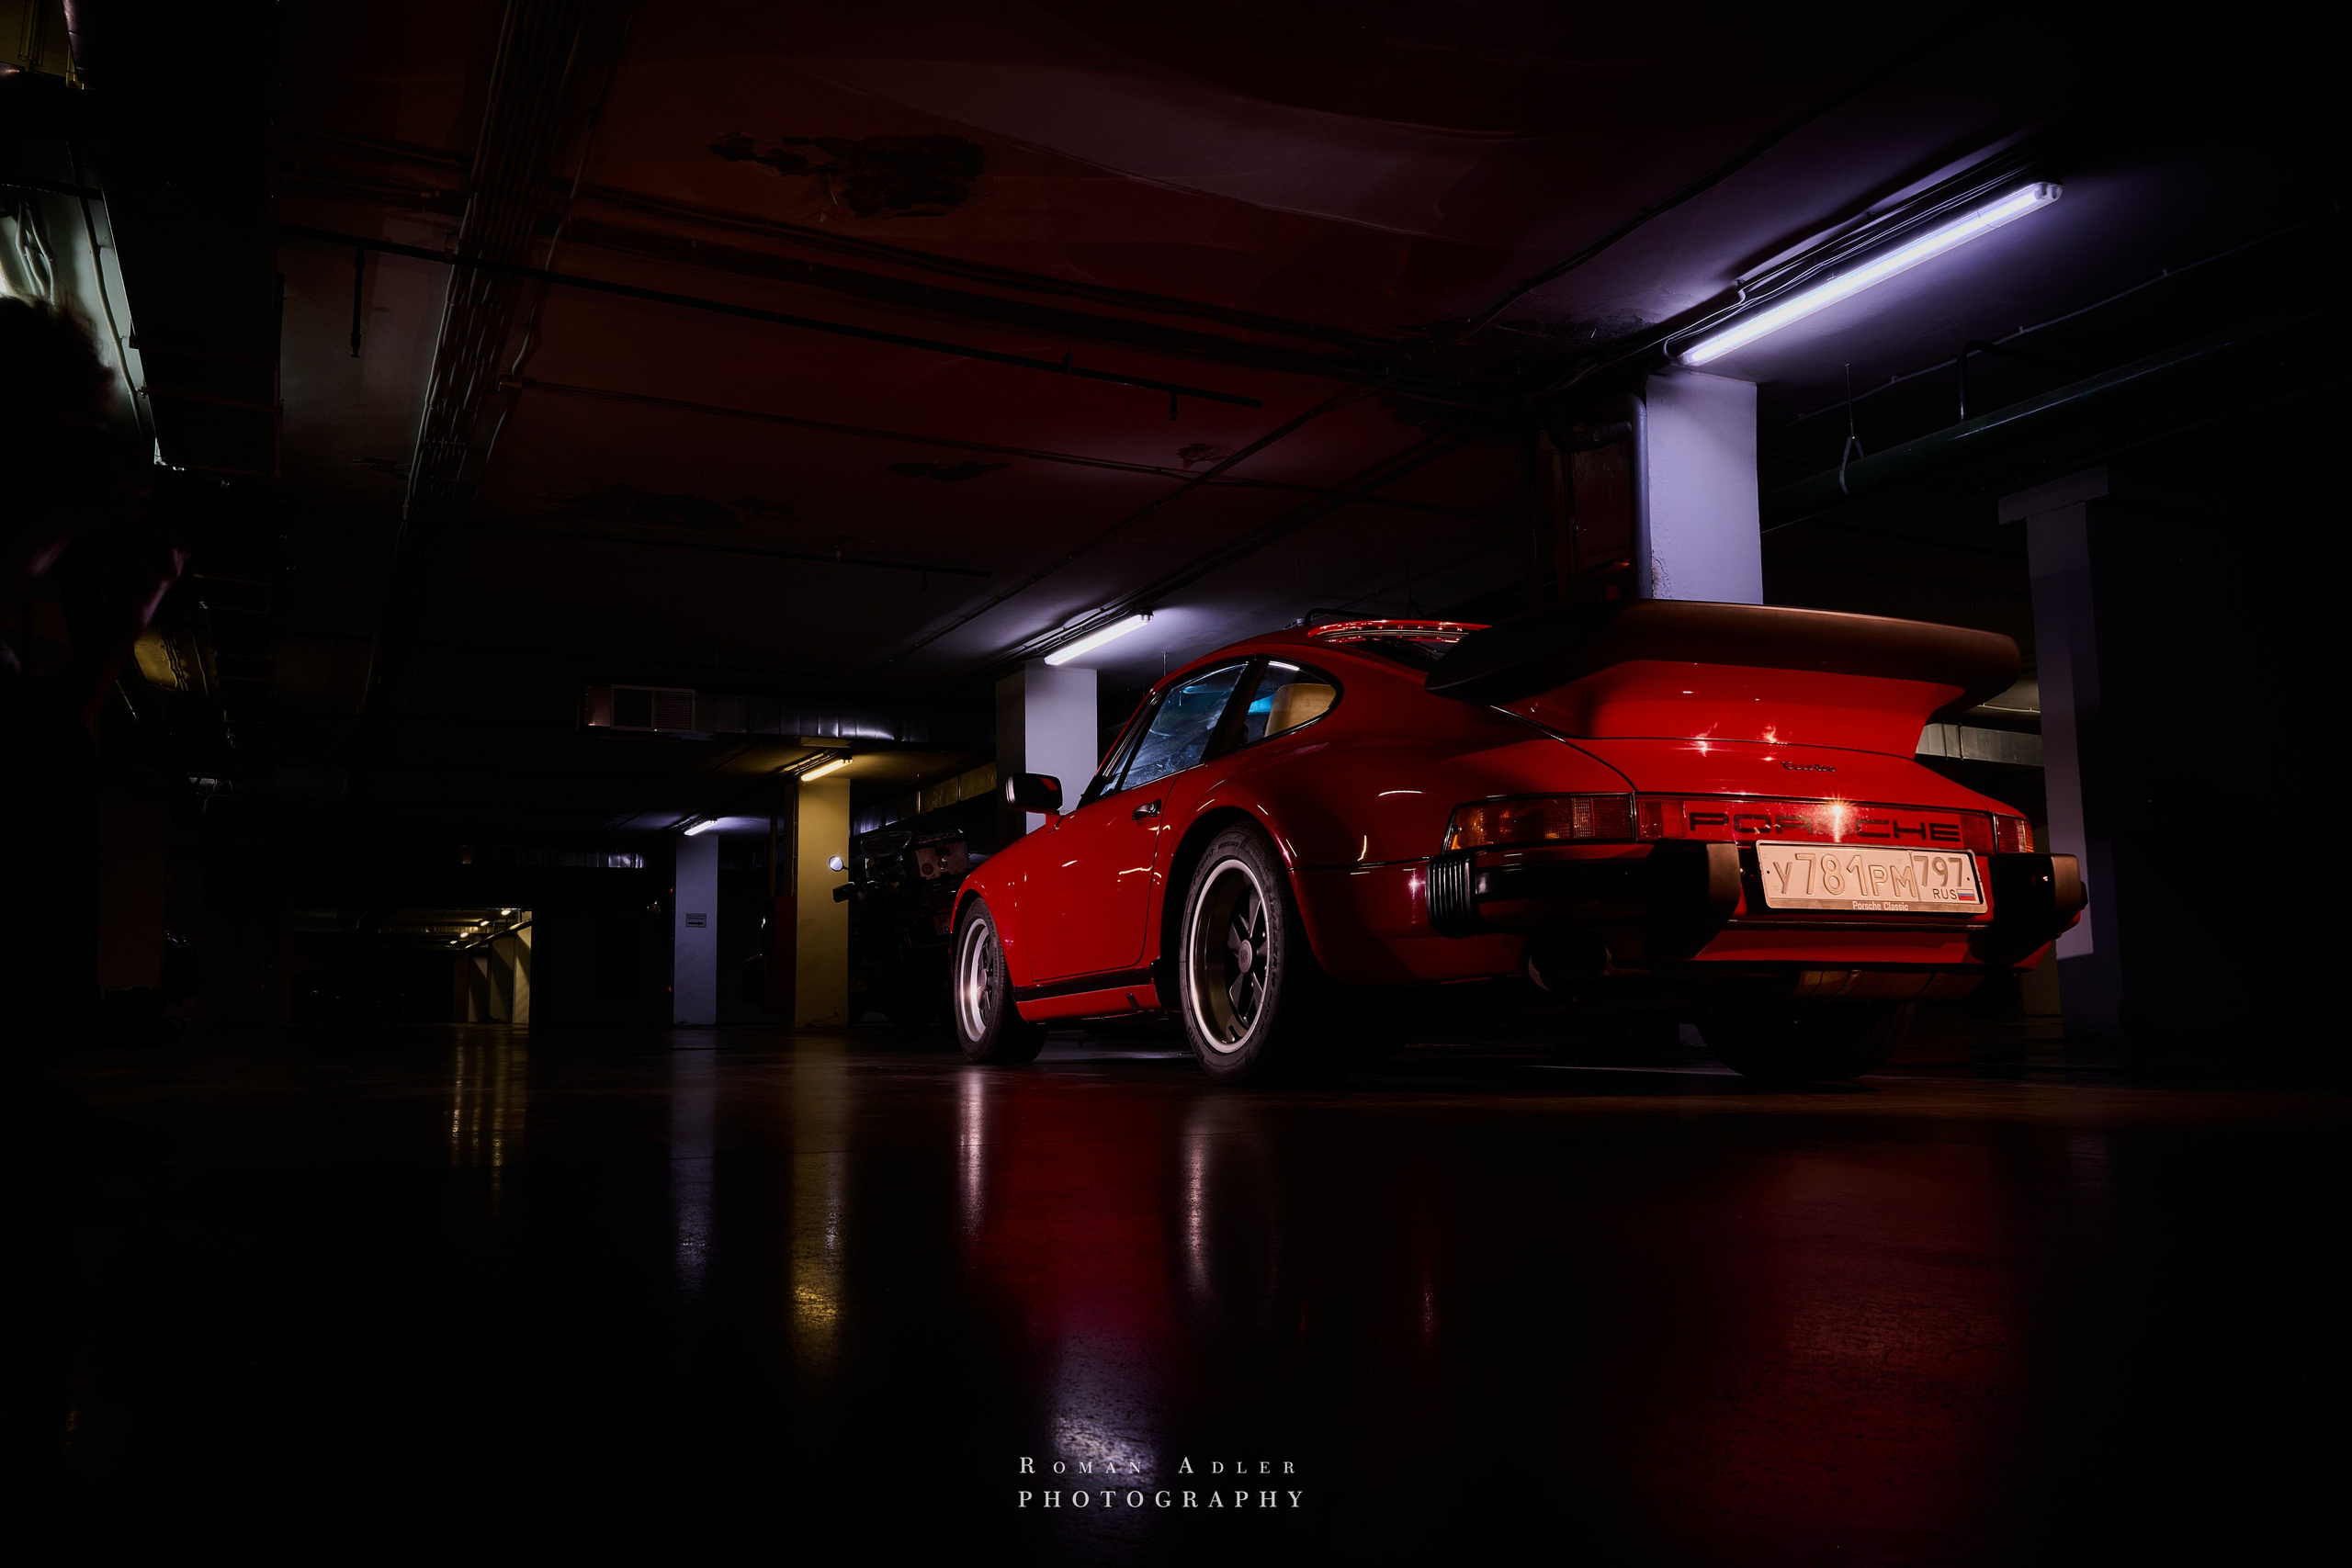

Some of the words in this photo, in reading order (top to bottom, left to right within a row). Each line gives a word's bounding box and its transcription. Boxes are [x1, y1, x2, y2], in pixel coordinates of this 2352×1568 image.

[1689, 812, 1962, 842] PORCHE
[1913, 855, 1963, 888] 797
[1932, 888, 1957, 899] RUS
[1852, 900, 1882, 910] Porsche
[1883, 902, 1909, 911] Classic
